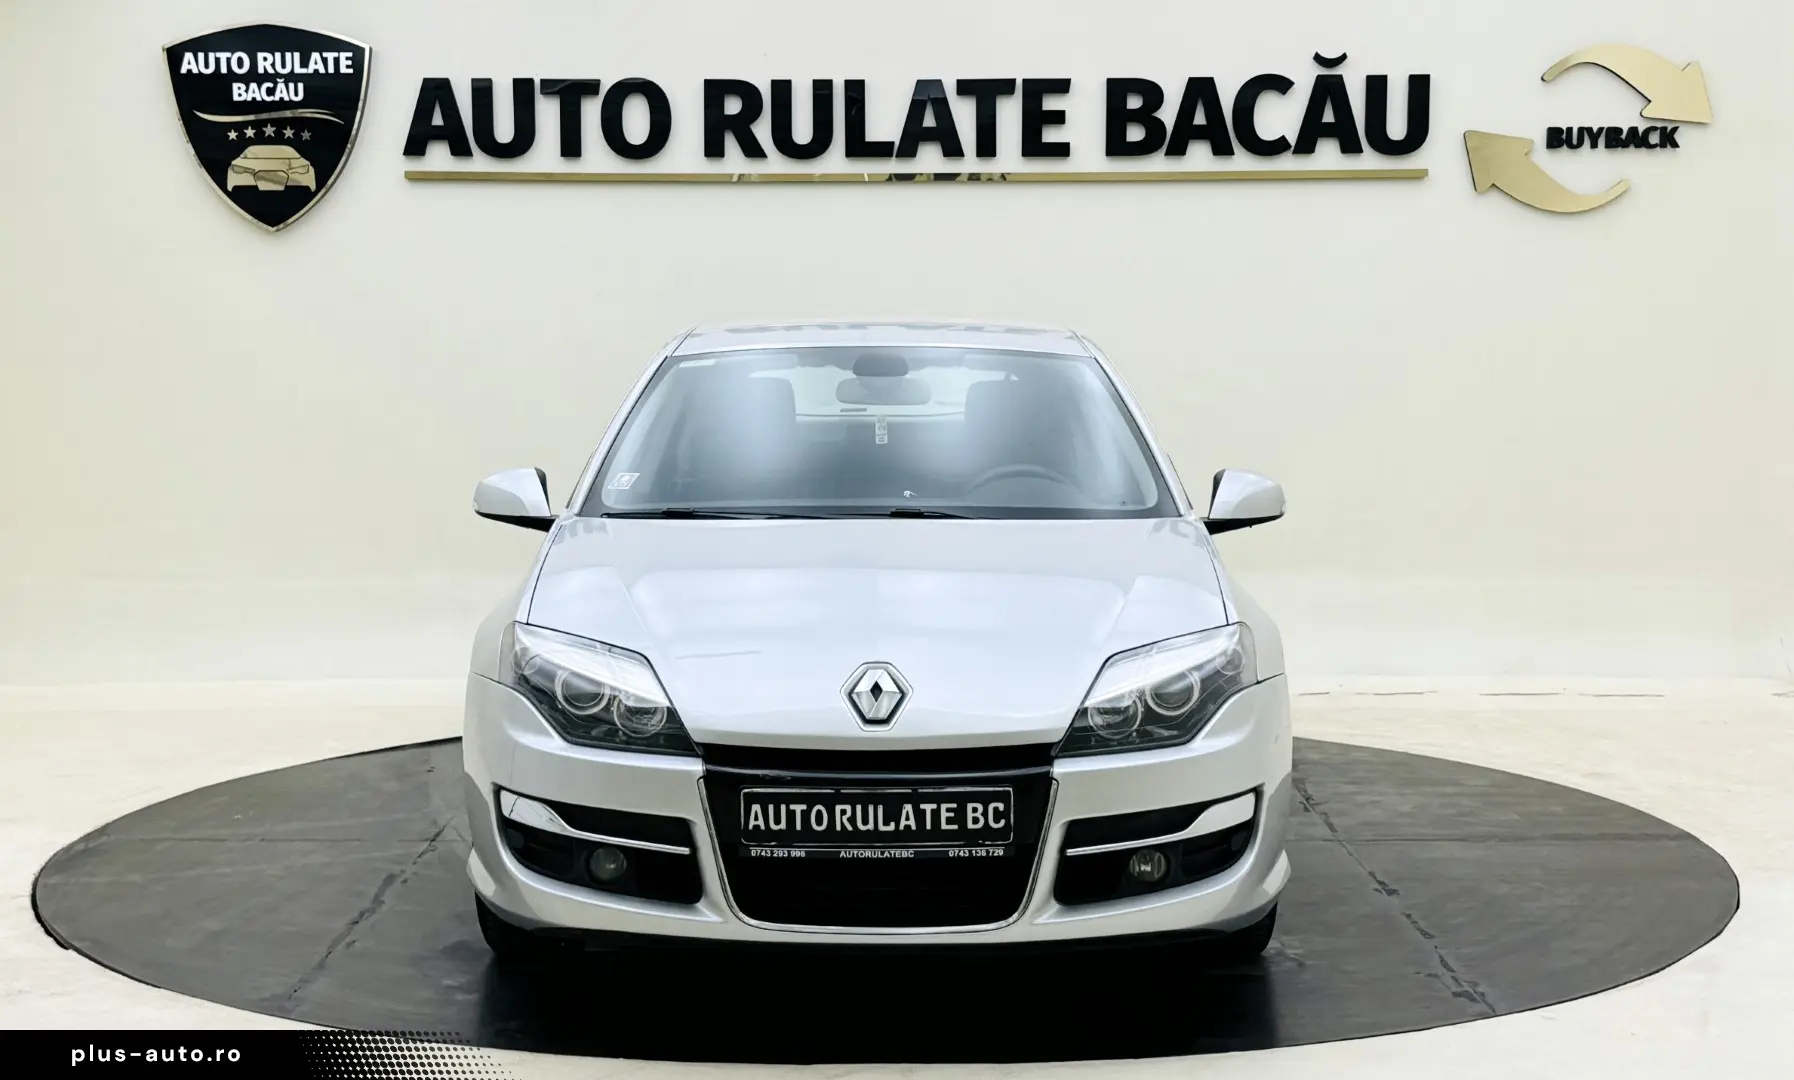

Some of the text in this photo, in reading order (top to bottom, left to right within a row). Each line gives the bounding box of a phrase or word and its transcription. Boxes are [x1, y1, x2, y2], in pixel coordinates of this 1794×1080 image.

[180, 52, 354, 74] AUTO RULATE
[232, 78, 304, 102] BACĂU
[402, 51, 1431, 159] AUTO RULATE BACĂU
[1546, 126, 1680, 150] BUYBACK
[966, 802, 1006, 830] BC
[750, 849, 771, 857] 0743
[772, 850, 788, 858] 293
[840, 850, 915, 858] AUTORULATEBC
